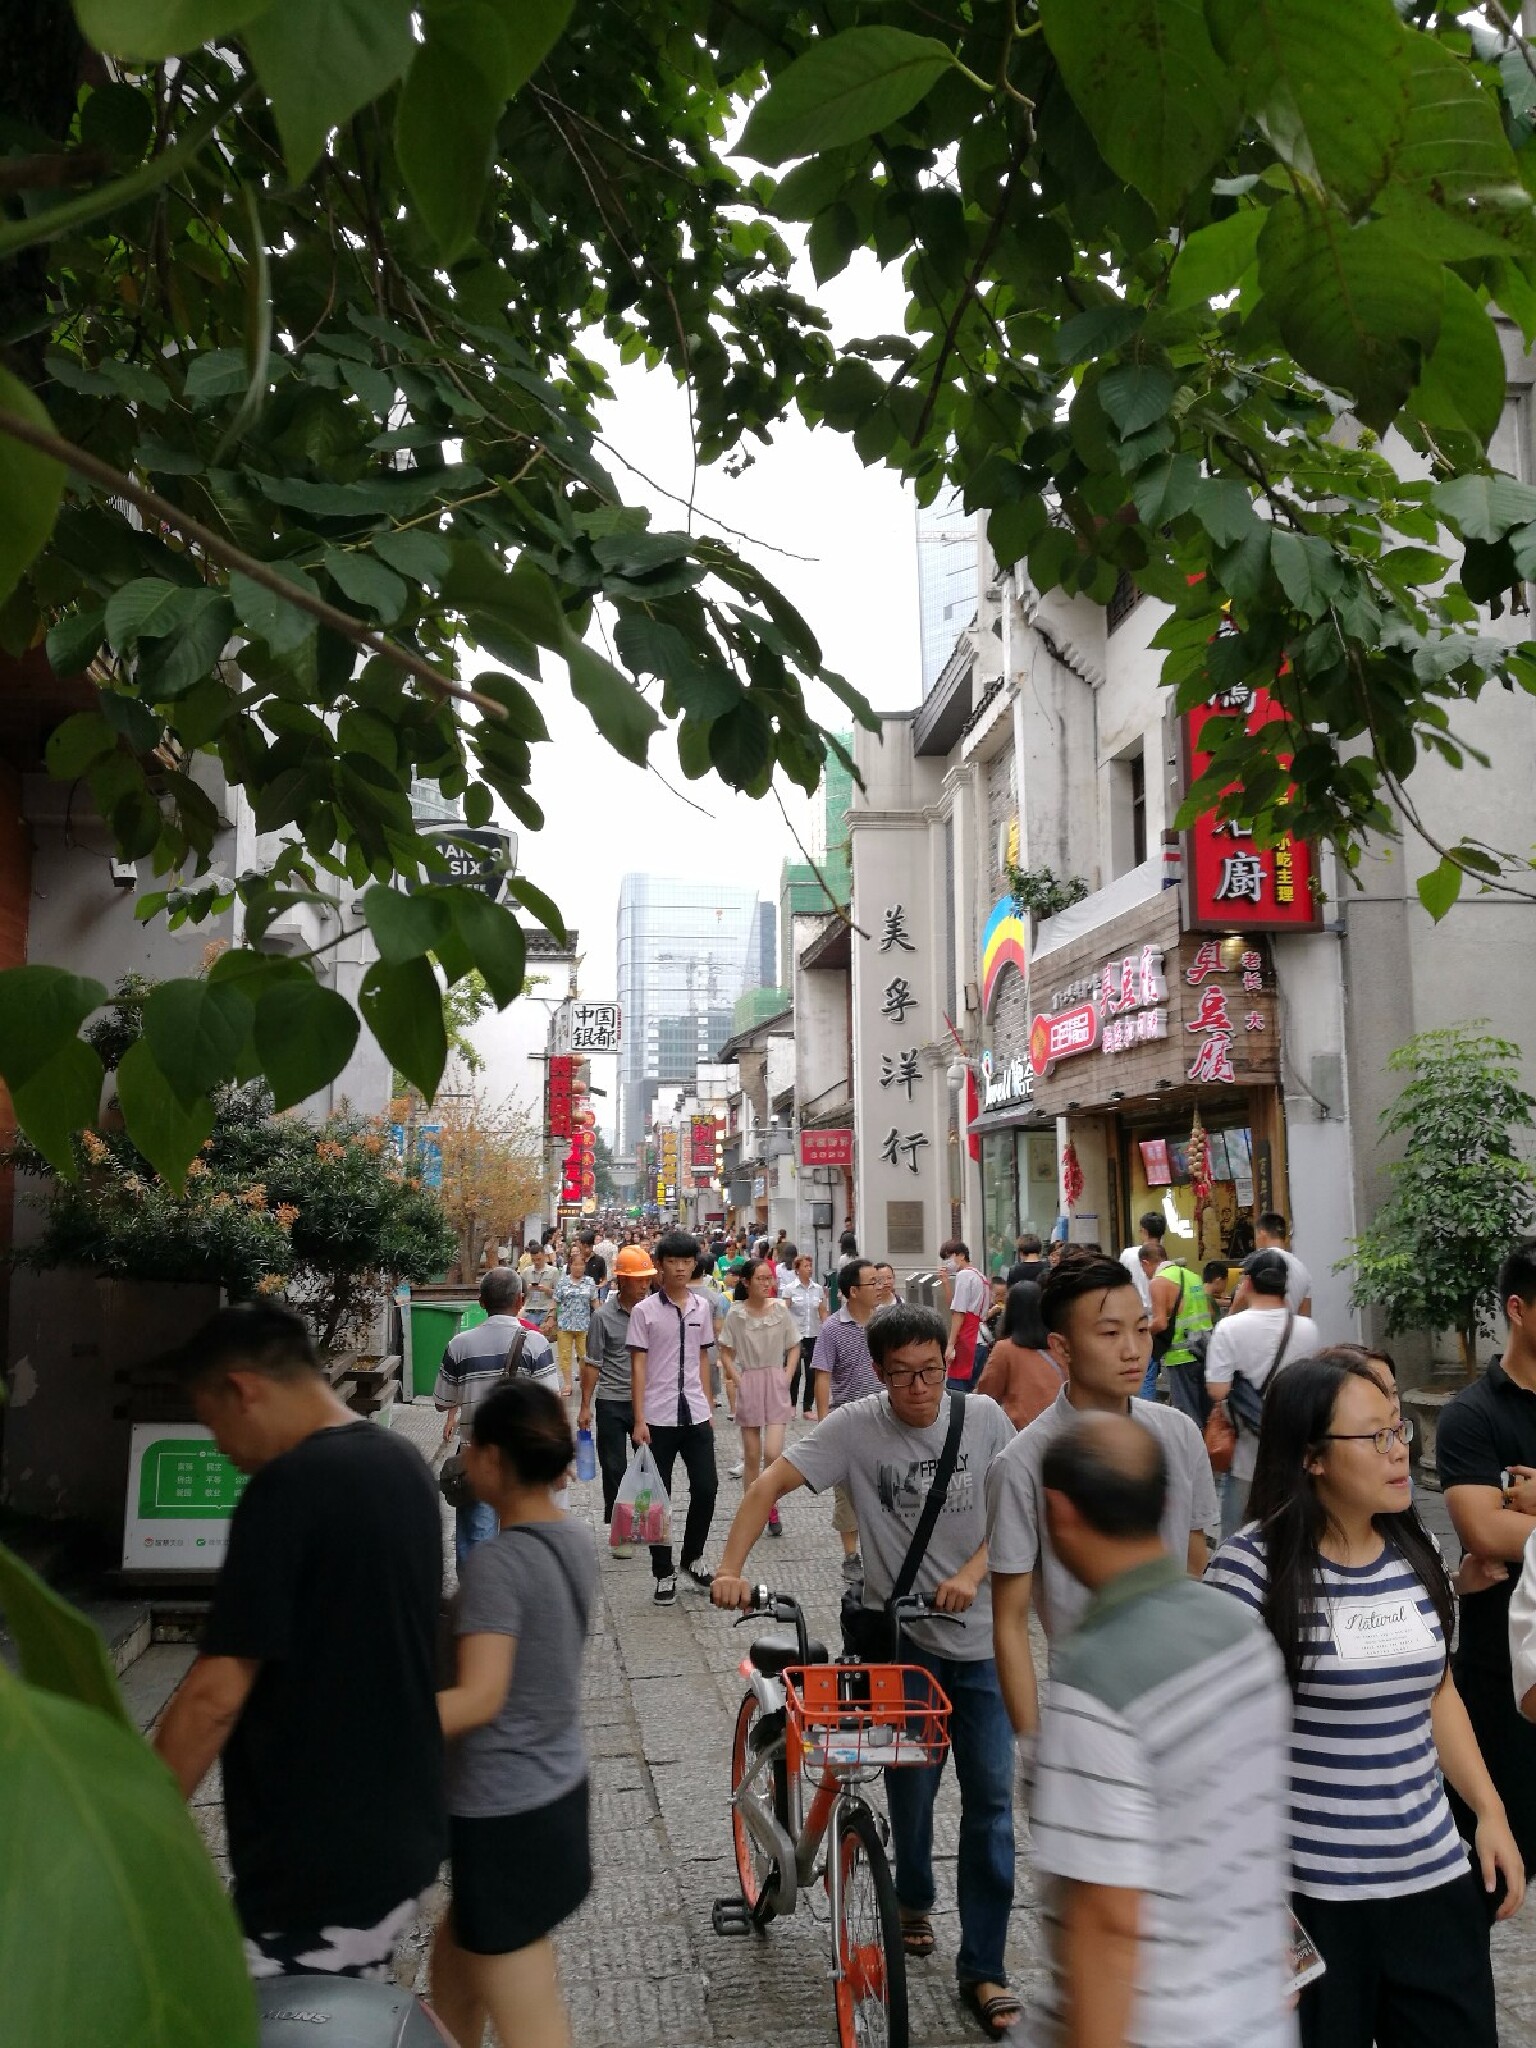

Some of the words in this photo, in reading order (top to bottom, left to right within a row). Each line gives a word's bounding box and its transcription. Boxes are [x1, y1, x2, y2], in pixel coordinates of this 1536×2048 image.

[450, 860, 481, 875] SIX
[879, 904, 931, 1176] 美孚洋行
[1345, 1605, 1407, 1631] Natural
